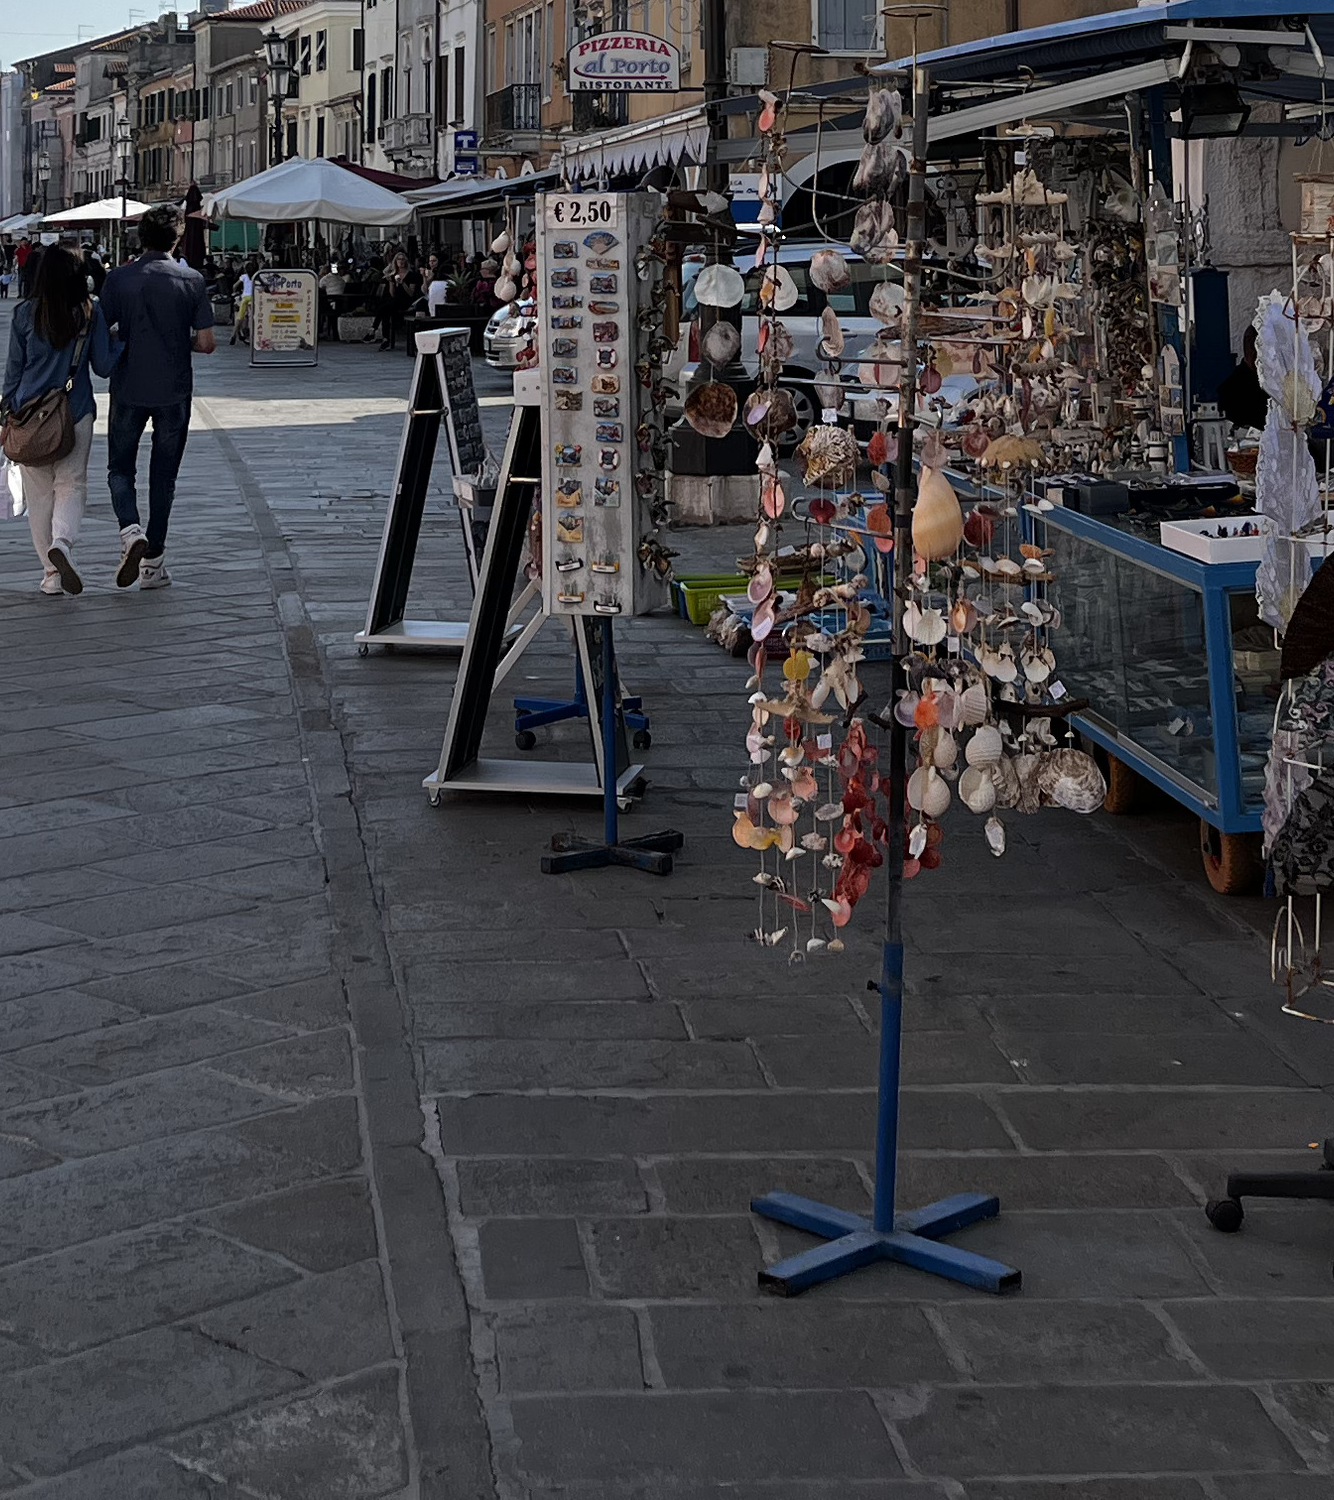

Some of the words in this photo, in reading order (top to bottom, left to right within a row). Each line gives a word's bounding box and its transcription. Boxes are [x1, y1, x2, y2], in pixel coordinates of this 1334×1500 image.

[578, 36, 672, 57] PIZZERIA
[583, 51, 607, 74] al
[610, 57, 671, 74] Porto
[579, 81, 673, 90] RISTORANTE
[570, 201, 611, 225] 2,50
